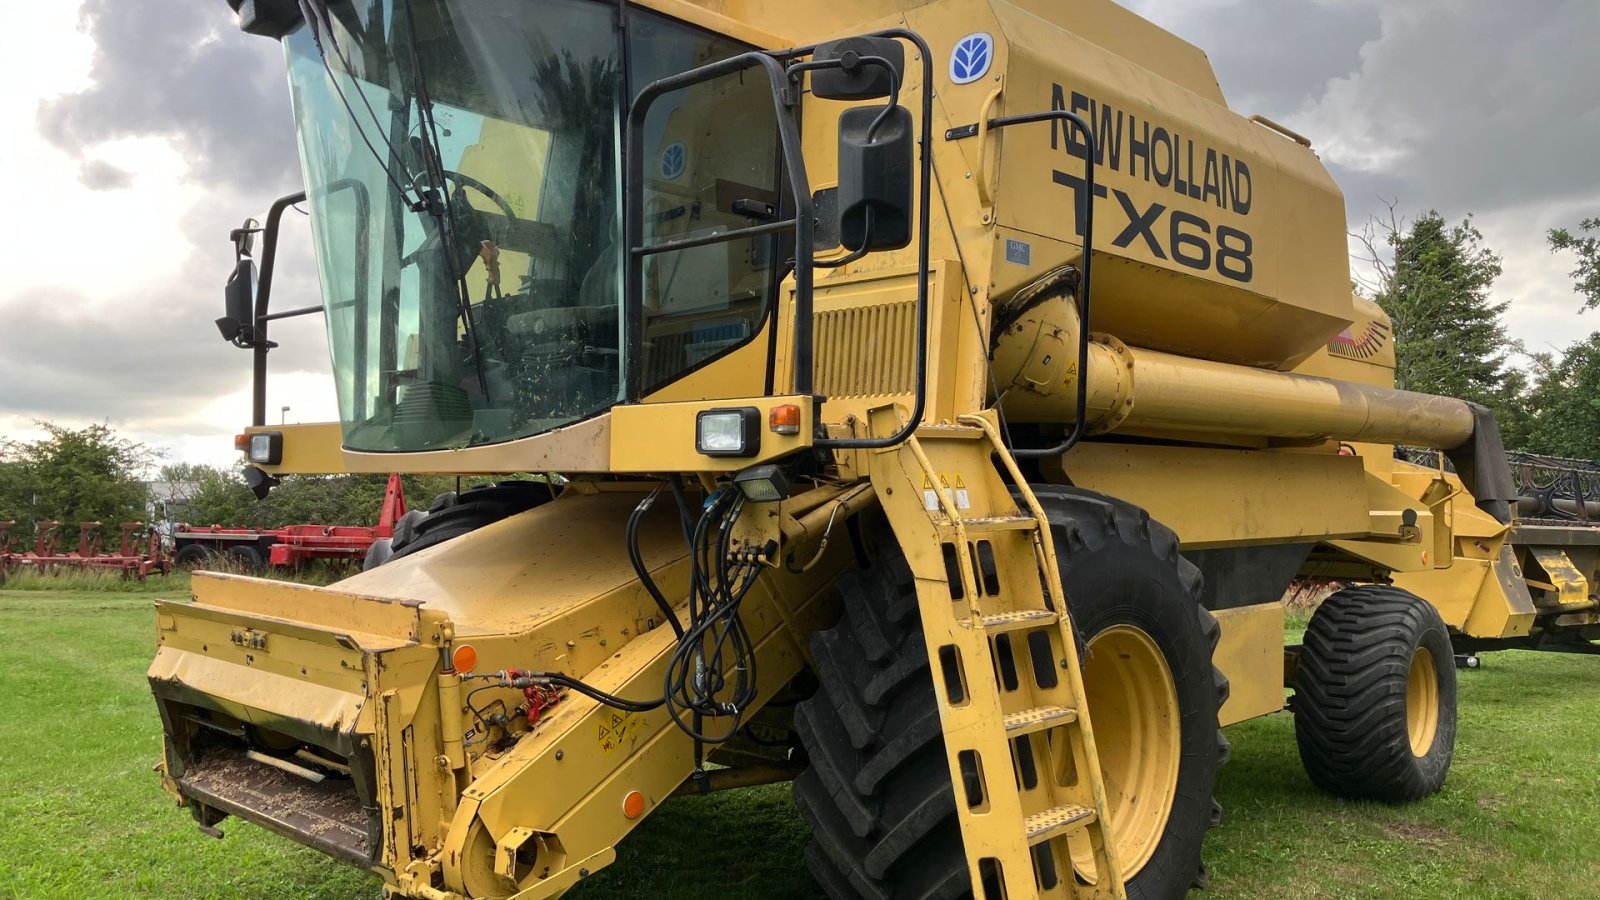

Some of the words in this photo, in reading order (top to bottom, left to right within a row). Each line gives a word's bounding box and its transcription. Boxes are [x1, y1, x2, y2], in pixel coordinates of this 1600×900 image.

[1051, 82, 1123, 172] NEW
[1130, 114, 1252, 216] HOLLAND
[1053, 169, 1253, 283] TX68
